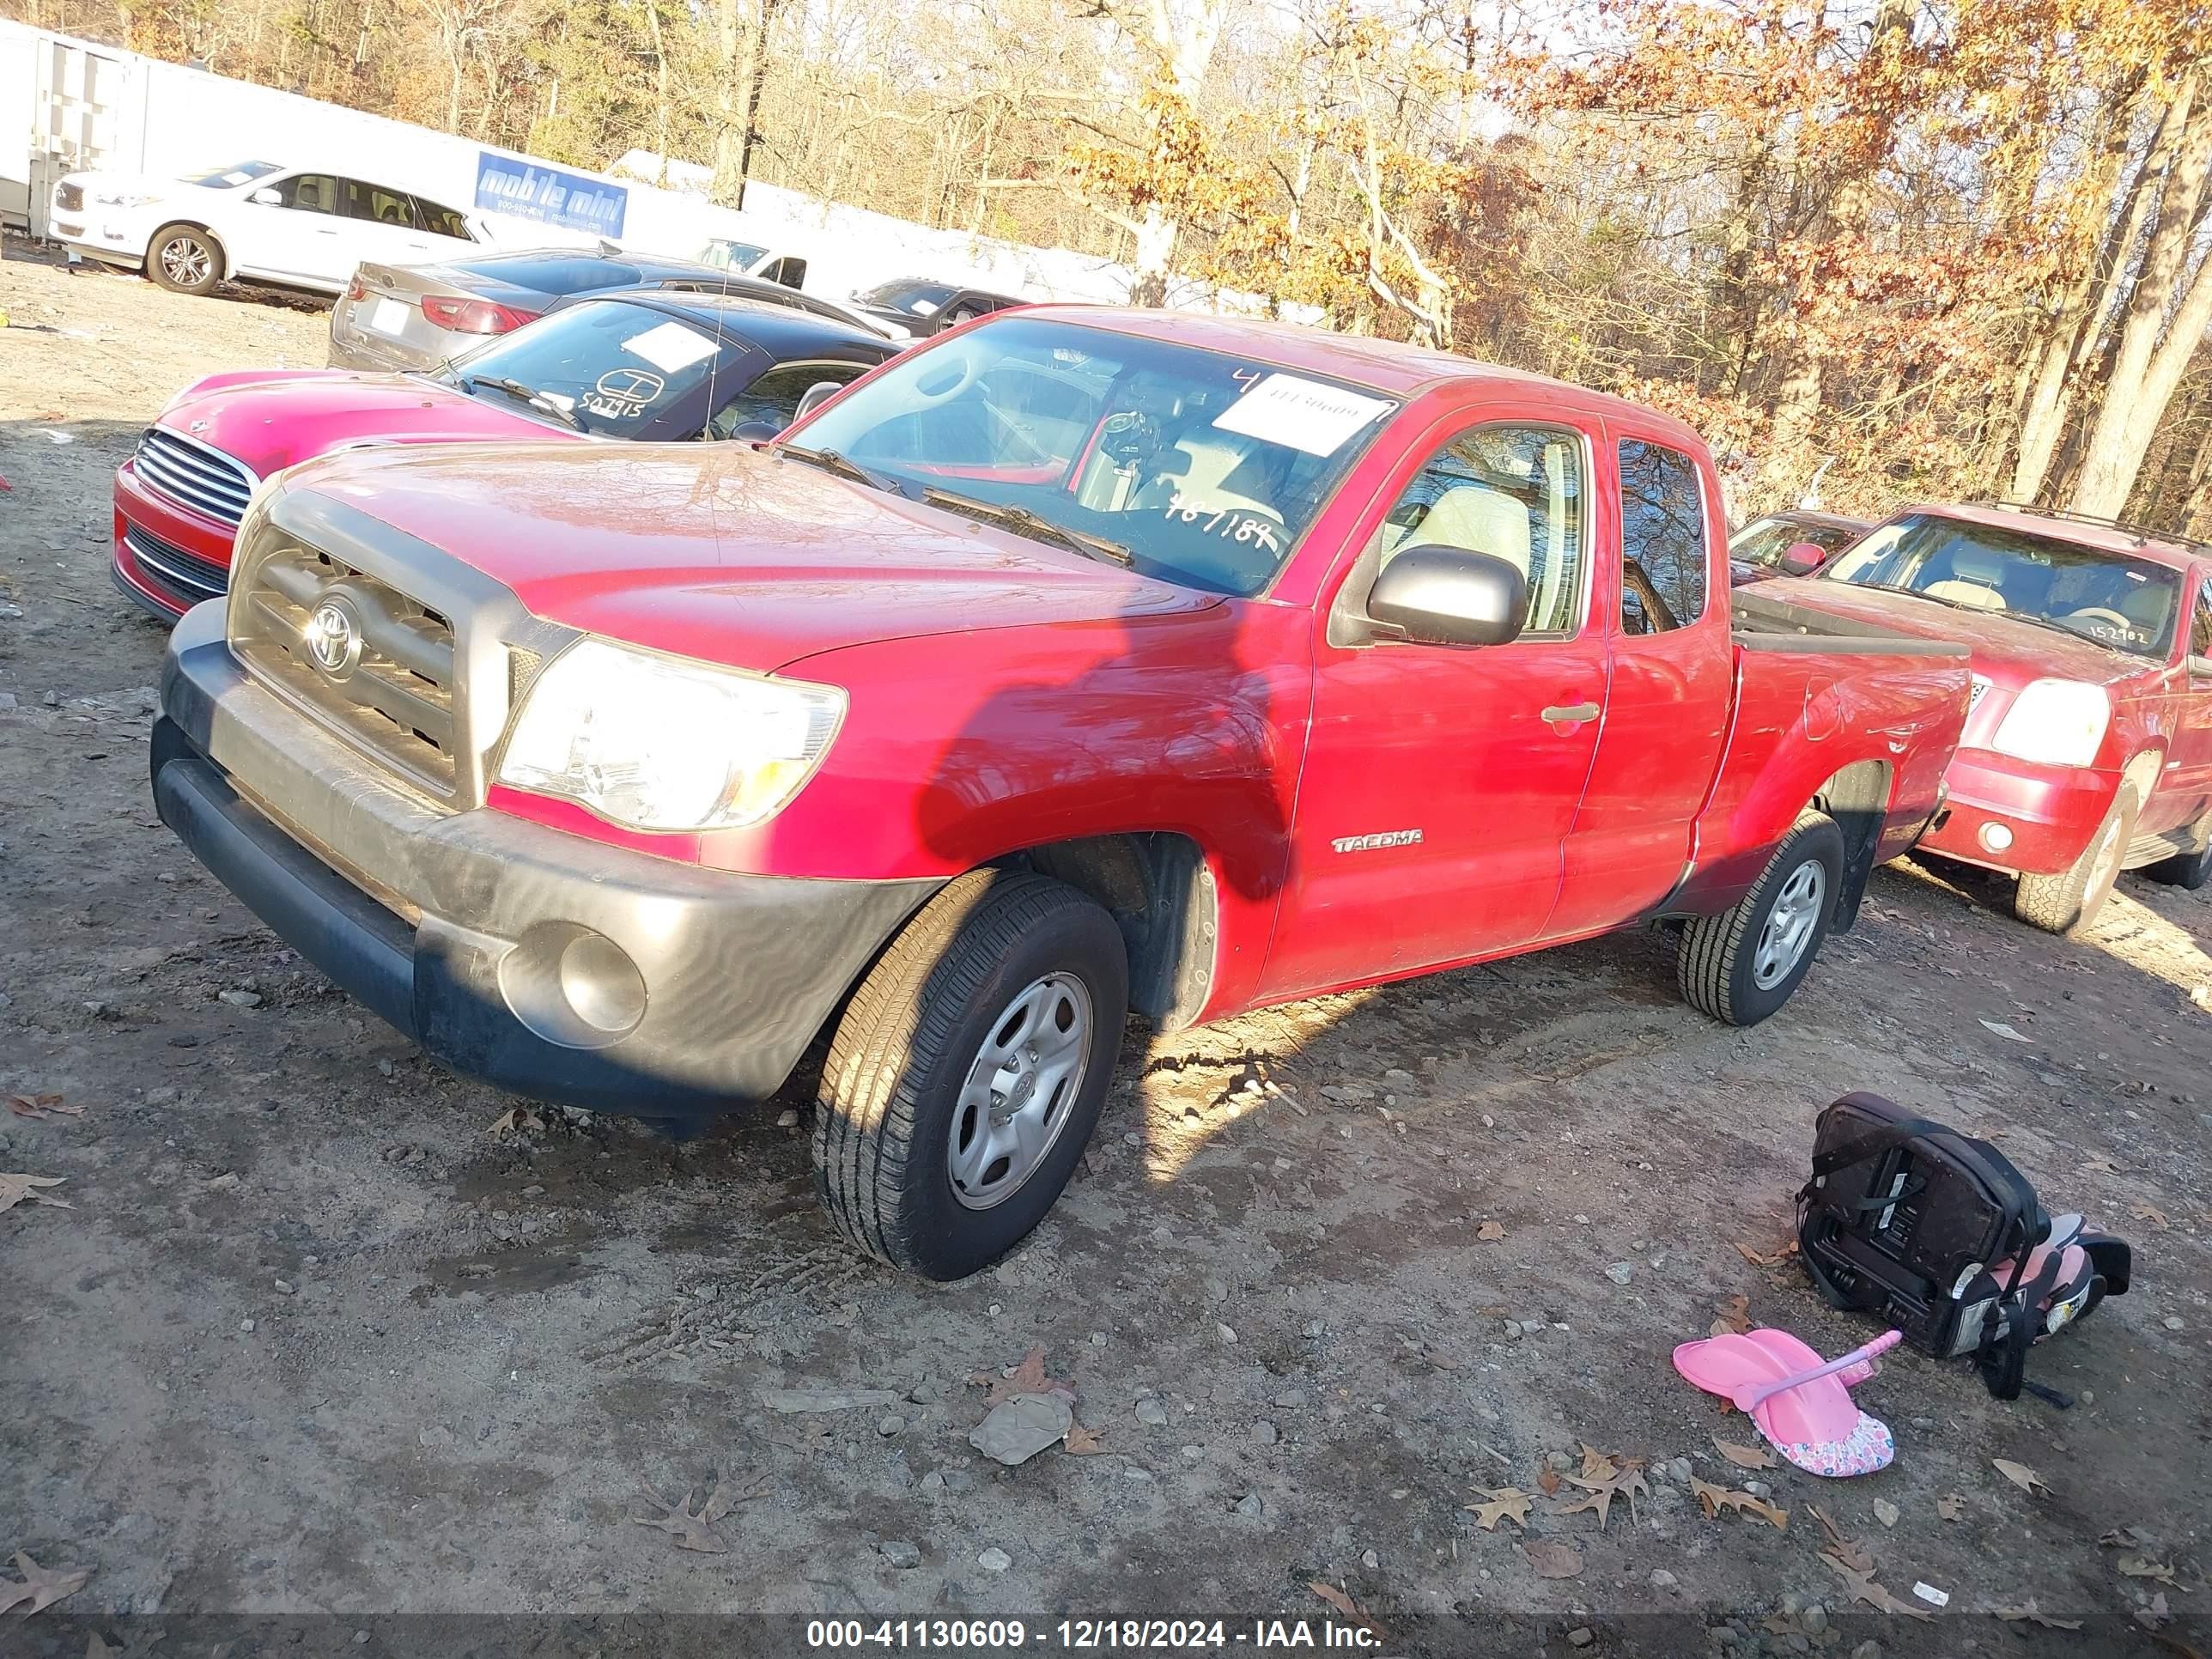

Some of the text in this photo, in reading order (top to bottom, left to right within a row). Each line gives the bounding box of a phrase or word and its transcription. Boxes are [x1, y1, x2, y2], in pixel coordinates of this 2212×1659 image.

[478, 167, 625, 221] mobile mini
[2090, 626, 2148, 644] 152982
[1331, 829, 1423, 853] TACOMA
